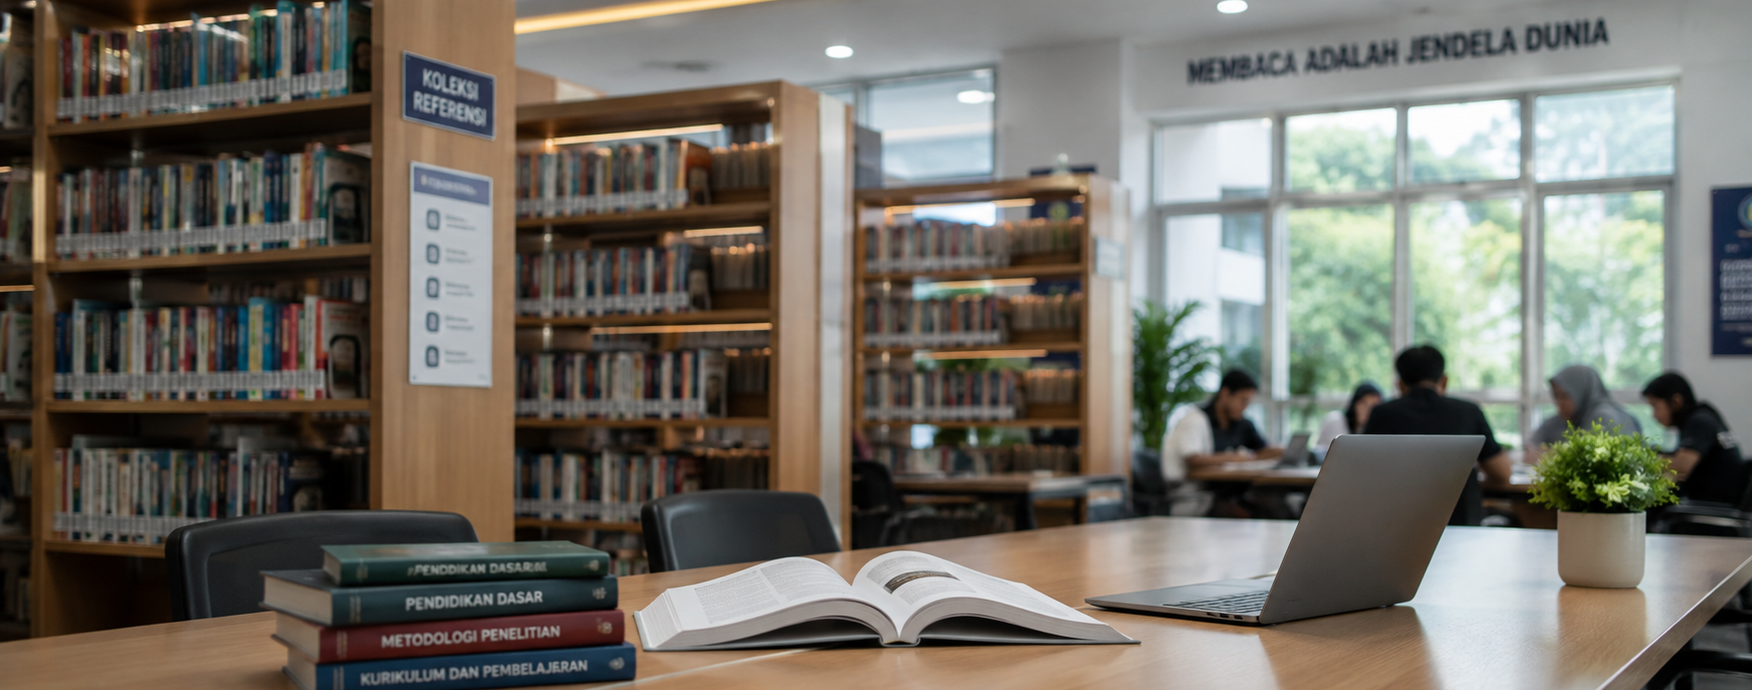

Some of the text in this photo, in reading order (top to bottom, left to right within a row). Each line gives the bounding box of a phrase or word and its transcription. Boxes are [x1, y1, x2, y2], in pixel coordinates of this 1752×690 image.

[1187, 17, 1610, 85] MEMBACA ADALAH JENDELA DUNIA
[422, 68, 479, 101] KOLEKSI
[413, 90, 487, 127] REFERENSI
[405, 590, 543, 611] PENDIDIKAN DASAR
[381, 625, 561, 648] METODOLOGI PENELITIAN
[360, 668, 446, 686] KURIKULUM
[449, 666, 479, 680] DAN
